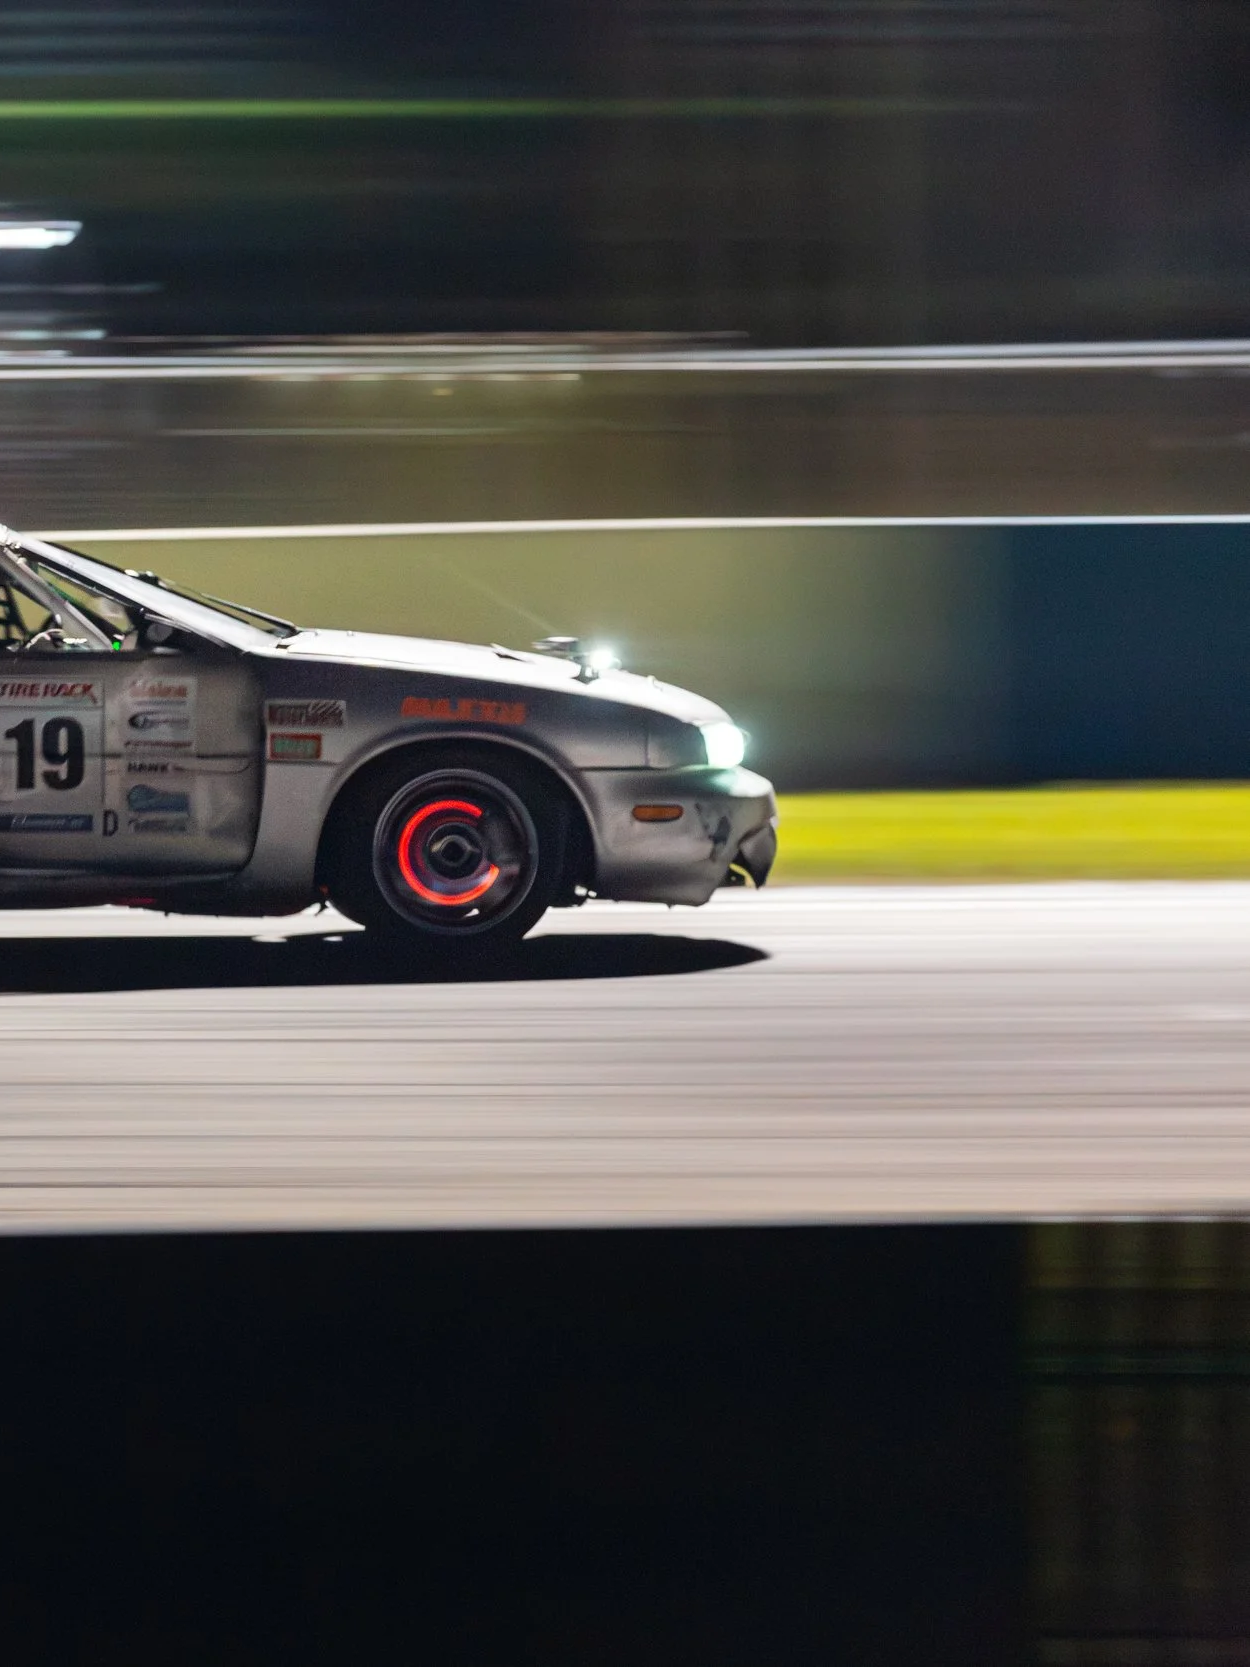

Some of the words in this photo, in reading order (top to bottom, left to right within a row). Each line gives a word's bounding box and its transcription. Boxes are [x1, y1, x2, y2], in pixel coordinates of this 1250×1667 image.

[42, 682, 98, 704] RACK
[5, 716, 85, 791] 19
[103, 809, 119, 837] D
